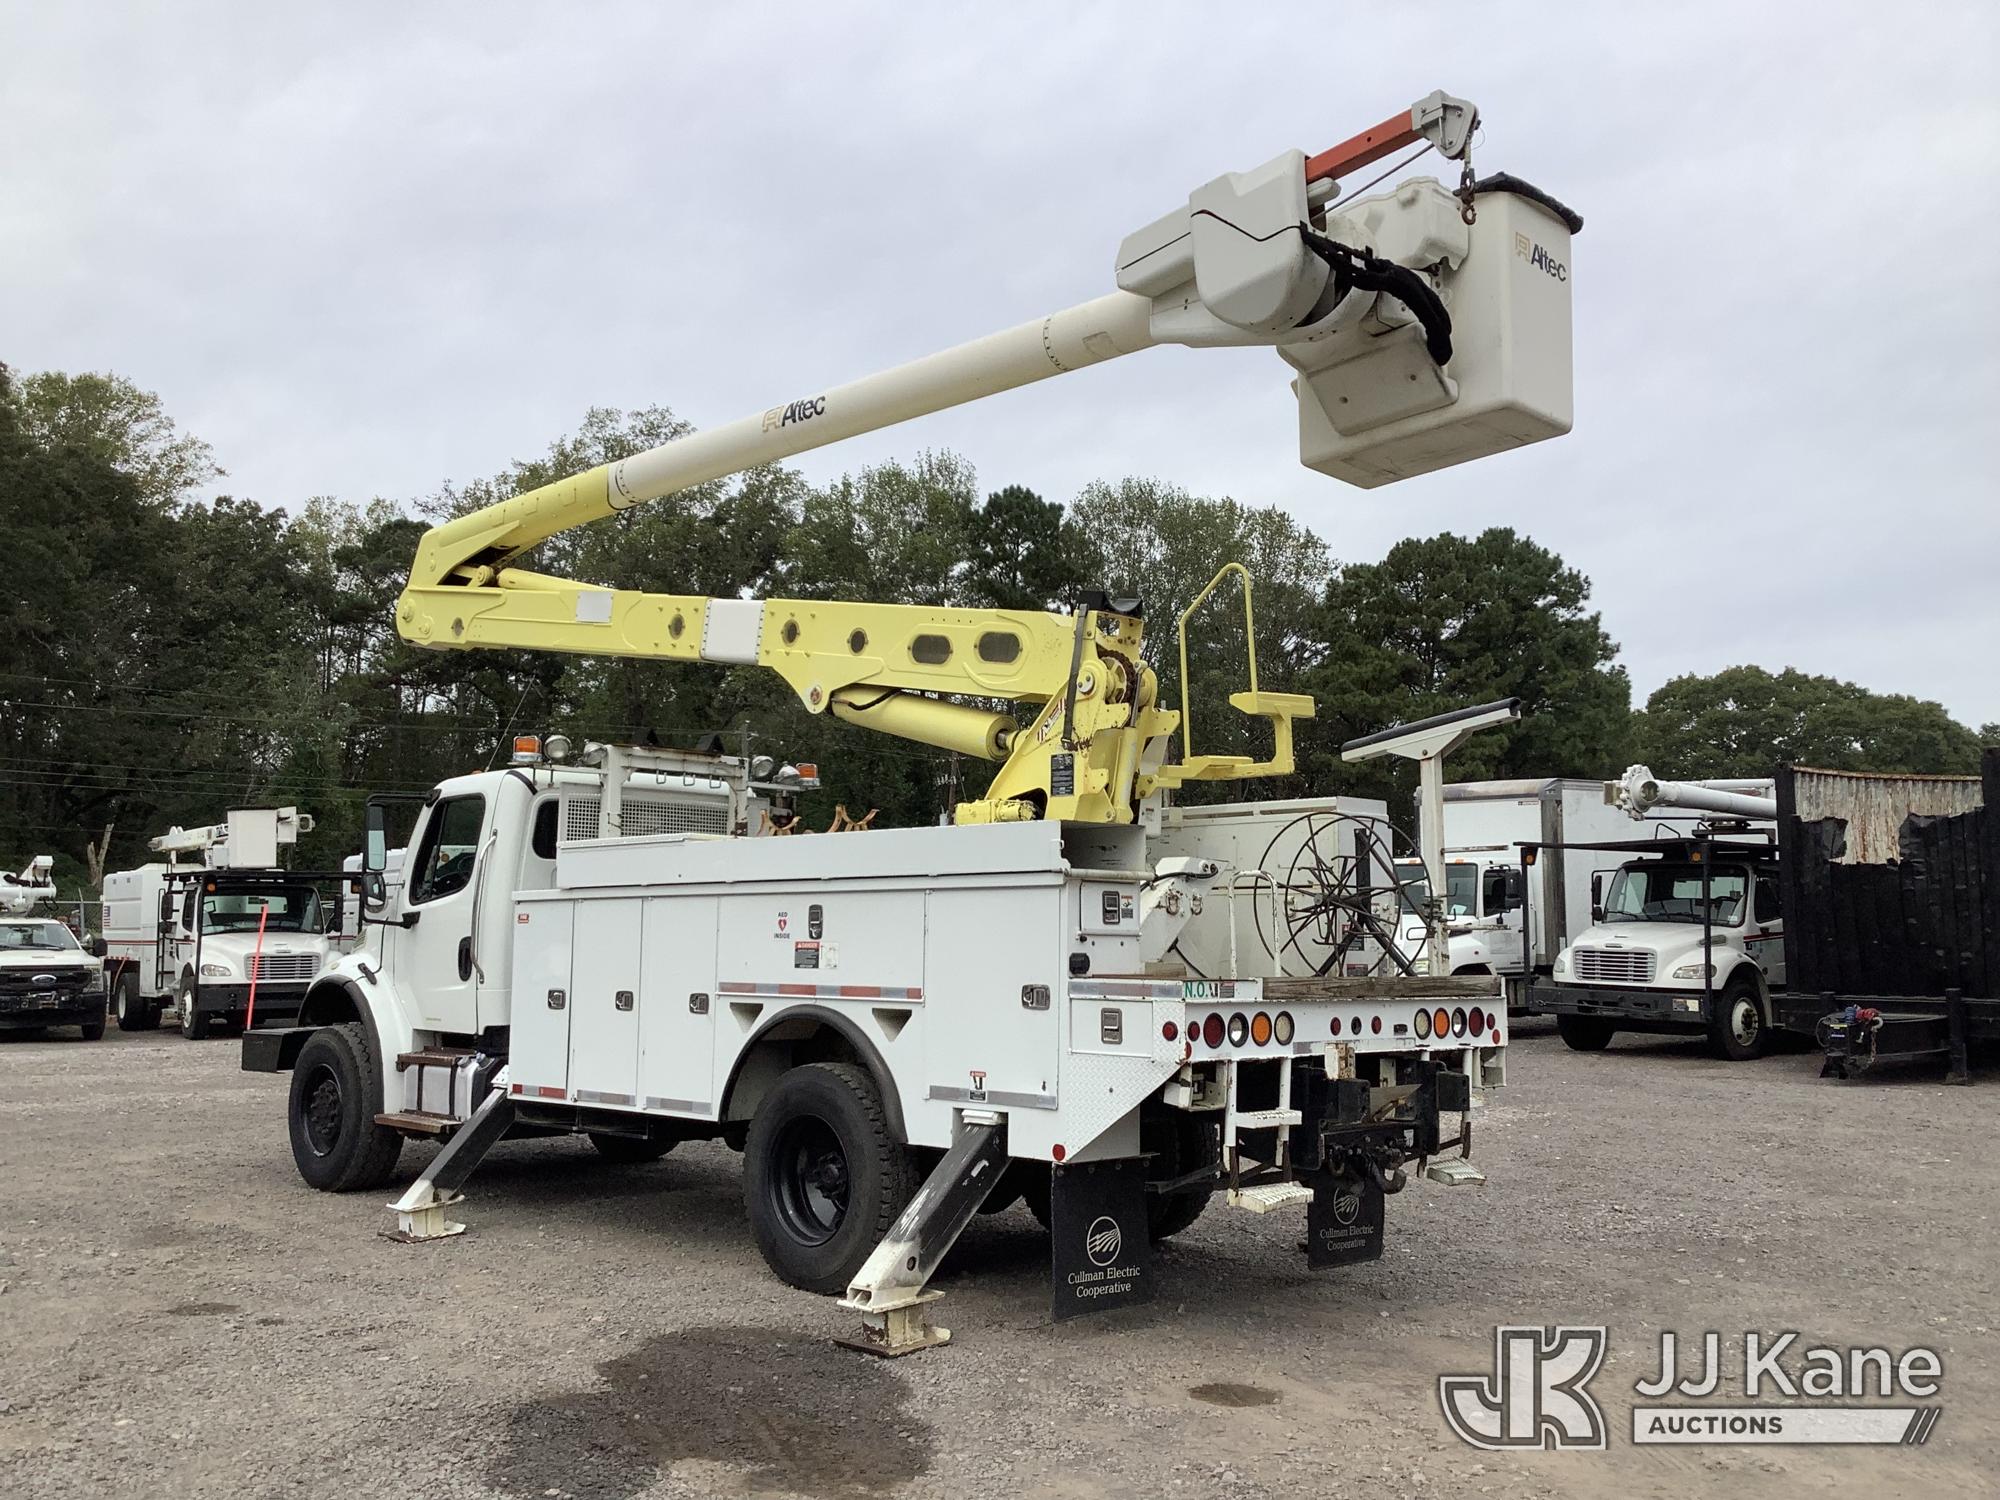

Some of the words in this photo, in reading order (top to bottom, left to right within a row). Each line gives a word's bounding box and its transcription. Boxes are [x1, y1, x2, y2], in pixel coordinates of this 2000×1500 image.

[1531, 243, 1567, 282] Altec
[781, 395, 826, 427] Altec
[1320, 1227, 1348, 1239] Cullman
[1349, 1224, 1374, 1236] Electric
[1327, 1238, 1366, 1251] Cooperative
[1068, 1270, 1105, 1285] Cullman
[1106, 1265, 1141, 1280] Electric
[1076, 1281, 1132, 1298] Cooperative
